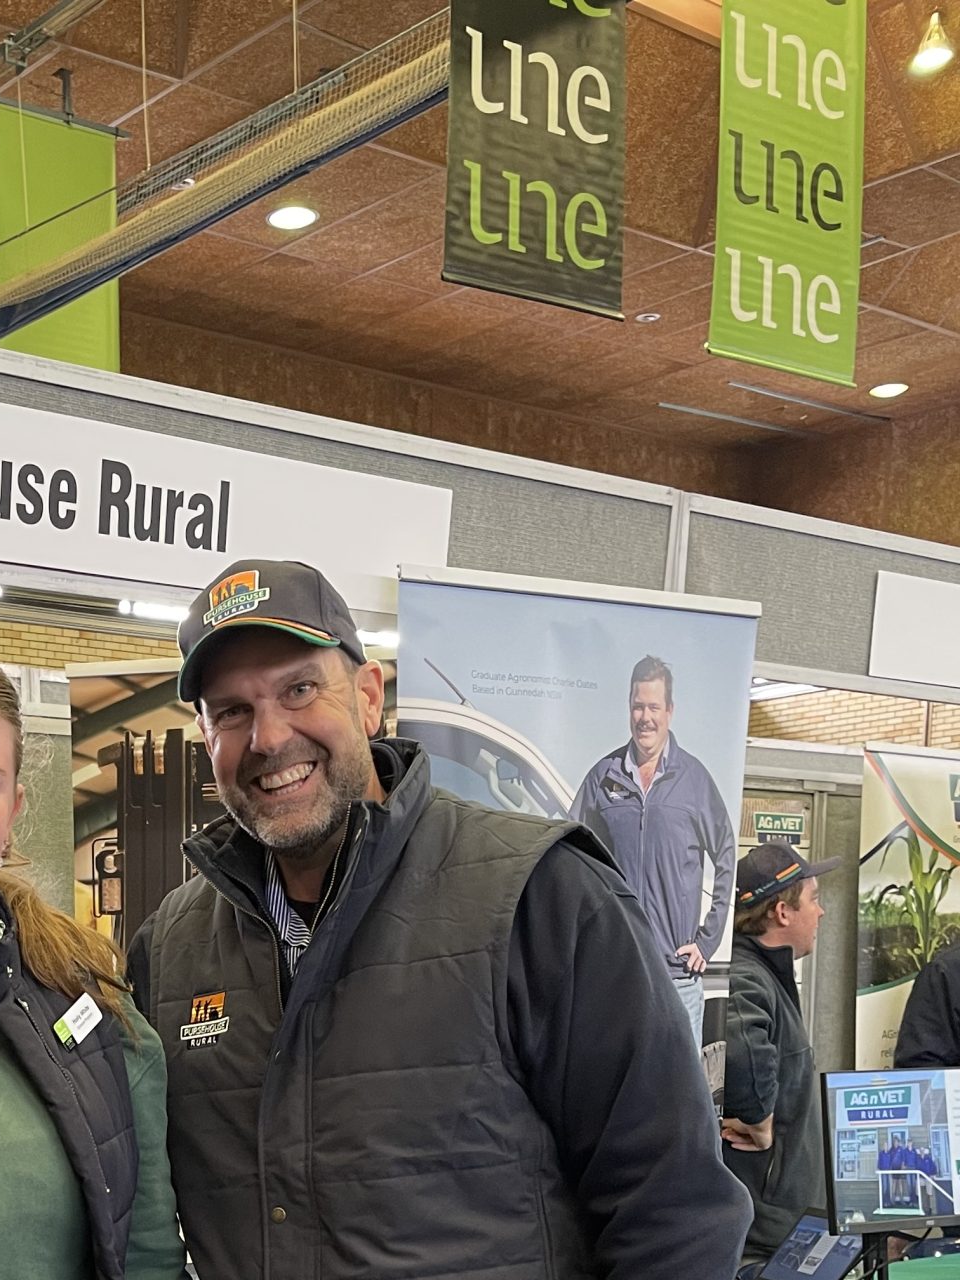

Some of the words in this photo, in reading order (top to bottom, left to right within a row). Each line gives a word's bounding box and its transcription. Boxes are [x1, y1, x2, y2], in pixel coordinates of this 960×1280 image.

[466, 26, 611, 143] une
[730, 11, 846, 119] une
[463, 159, 607, 269] une
[728, 130, 843, 231] une
[725, 248, 840, 343] une
[98, 459, 230, 552] Rural
[206, 591, 264, 619] PURSEHOUSE
[218, 604, 250, 620] RURAL
[471, 670, 505, 680] Graduate
[191, 1036, 216, 1046] RURAL
[861, 1110, 894, 1119] RURAL
